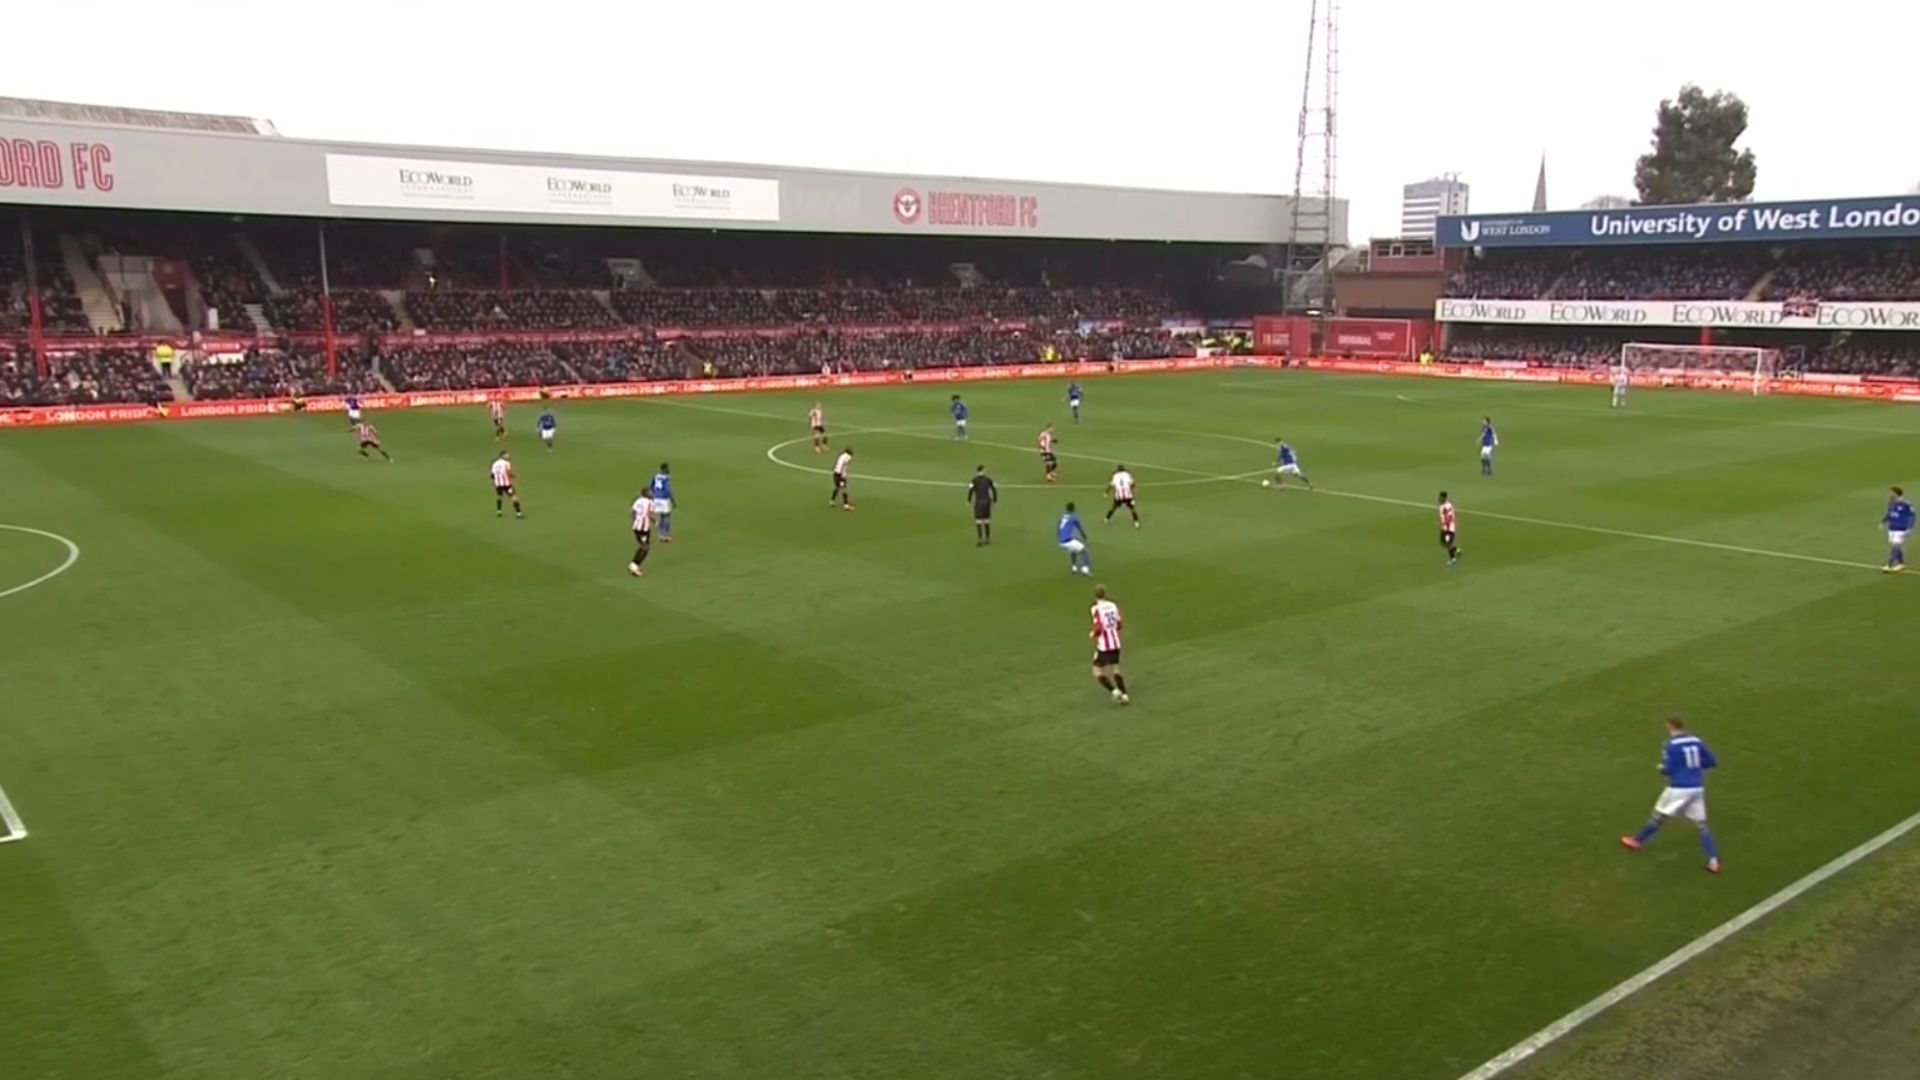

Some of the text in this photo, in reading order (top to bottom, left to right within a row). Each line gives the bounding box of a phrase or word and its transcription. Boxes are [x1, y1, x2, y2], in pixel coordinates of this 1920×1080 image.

[70, 143, 114, 191] FC
[1020, 197, 1038, 227] FC
[1592, 203, 1920, 238] University of West Londo
[1509, 225, 1550, 236] LONDON
[46, 410, 106, 422] LONDON
[181, 402, 274, 416] LONDON PRIDE
[1682, 745, 1700, 769] 11
